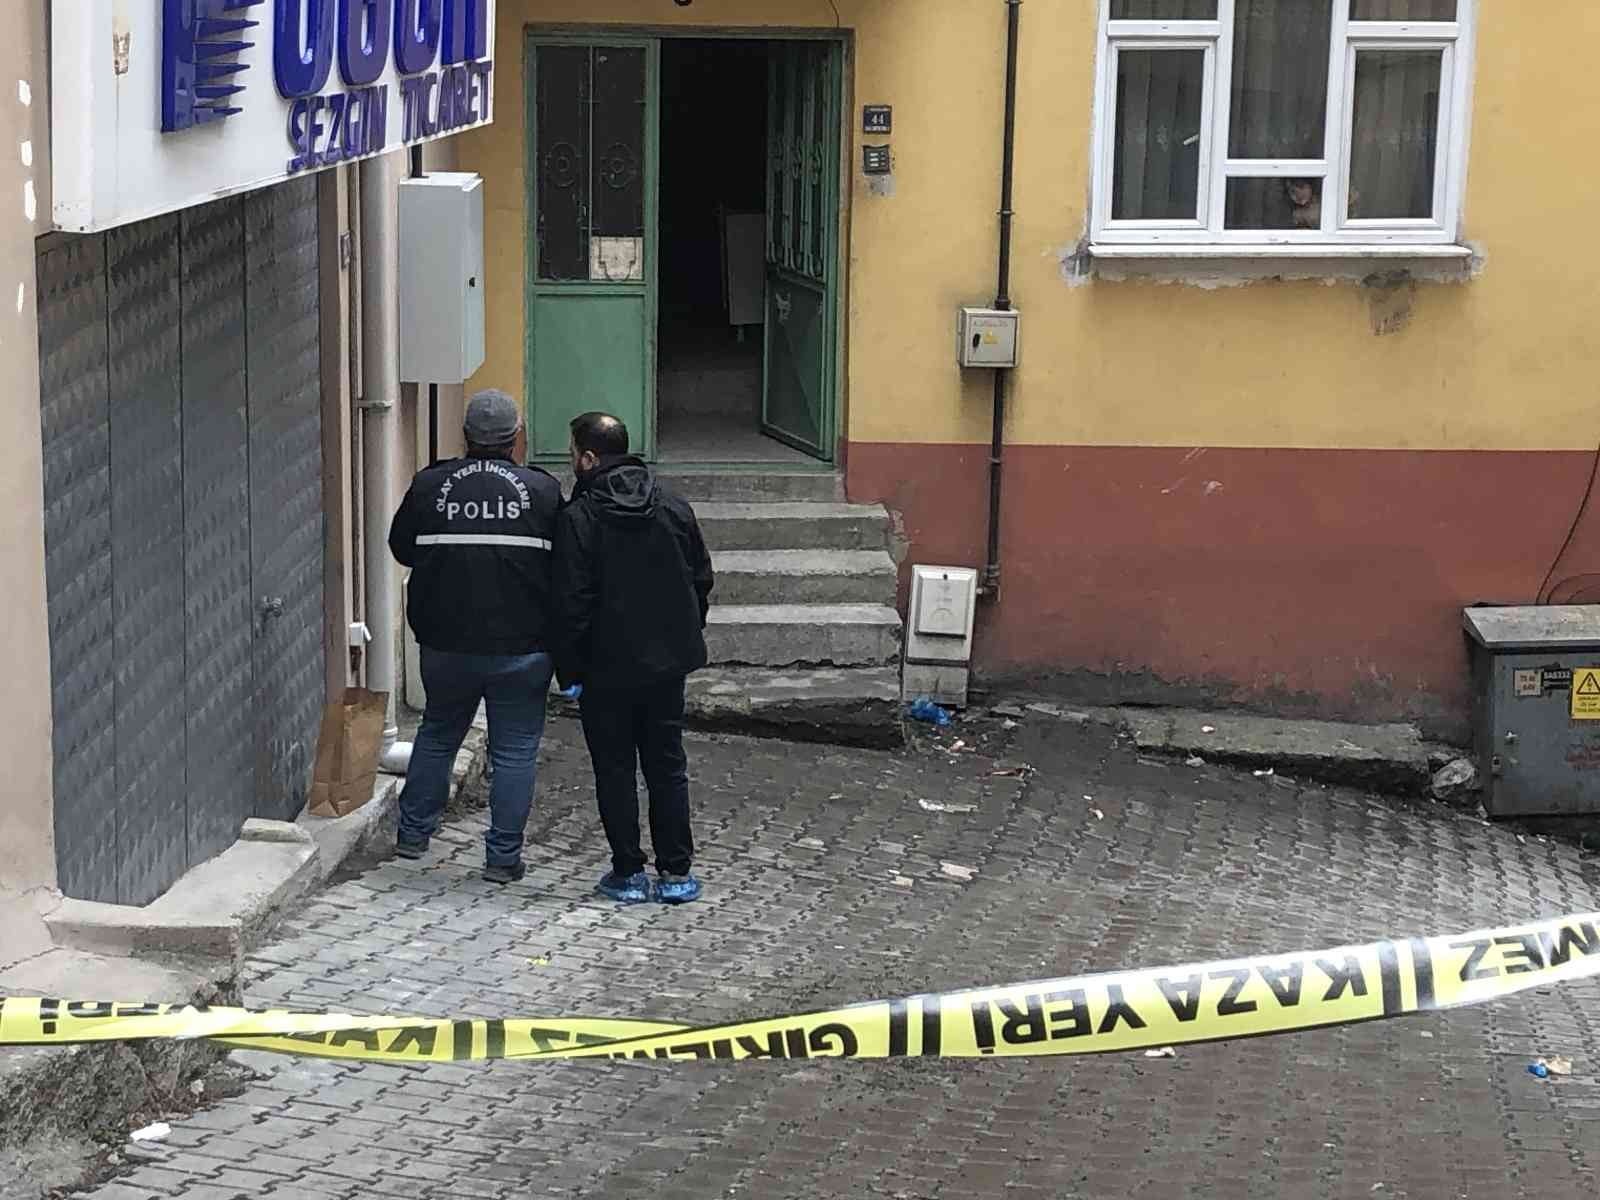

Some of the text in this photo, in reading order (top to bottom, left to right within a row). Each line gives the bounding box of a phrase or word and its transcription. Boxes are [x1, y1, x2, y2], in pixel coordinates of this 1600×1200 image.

[436, 478, 453, 512] OLAY
[447, 496, 520, 520] POLİS
[1155, 955, 1368, 1022] KAZA
